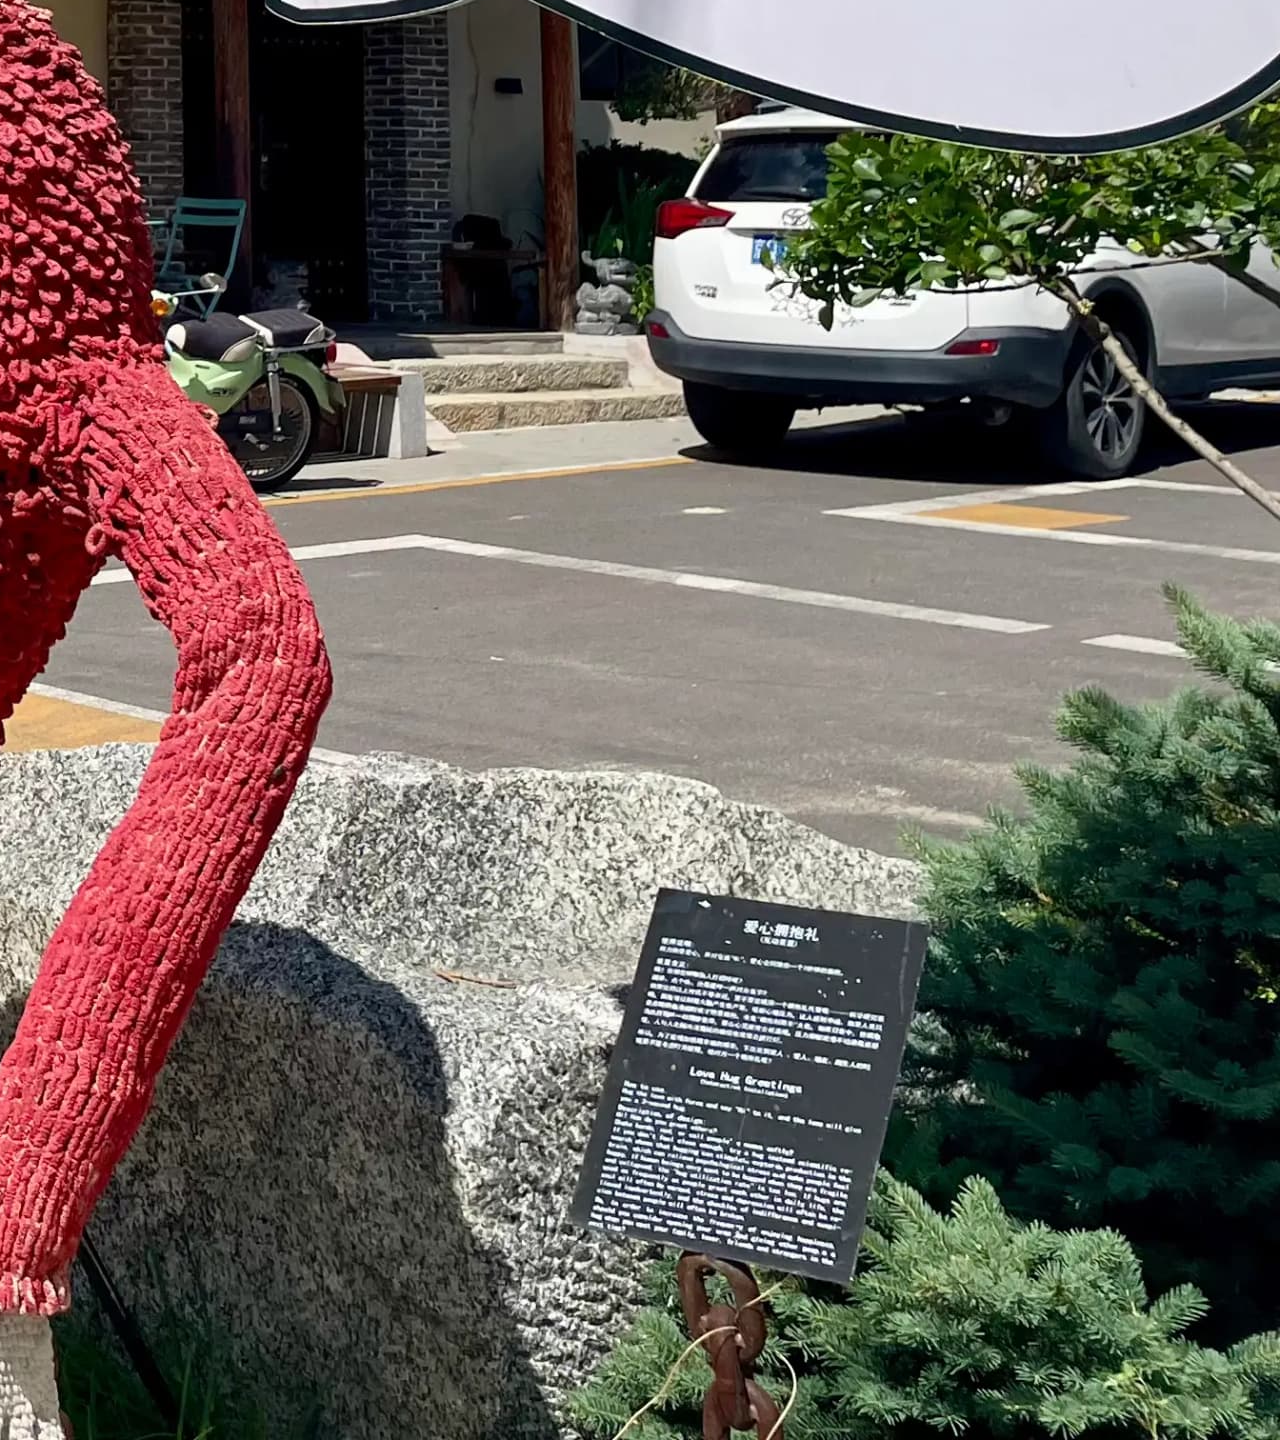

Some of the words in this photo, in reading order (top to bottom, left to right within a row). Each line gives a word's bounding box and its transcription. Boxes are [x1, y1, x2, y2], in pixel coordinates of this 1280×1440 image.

[689, 1066, 716, 1079] Love
[720, 1071, 741, 1085] Hug
[745, 1075, 802, 1094] Greetings
